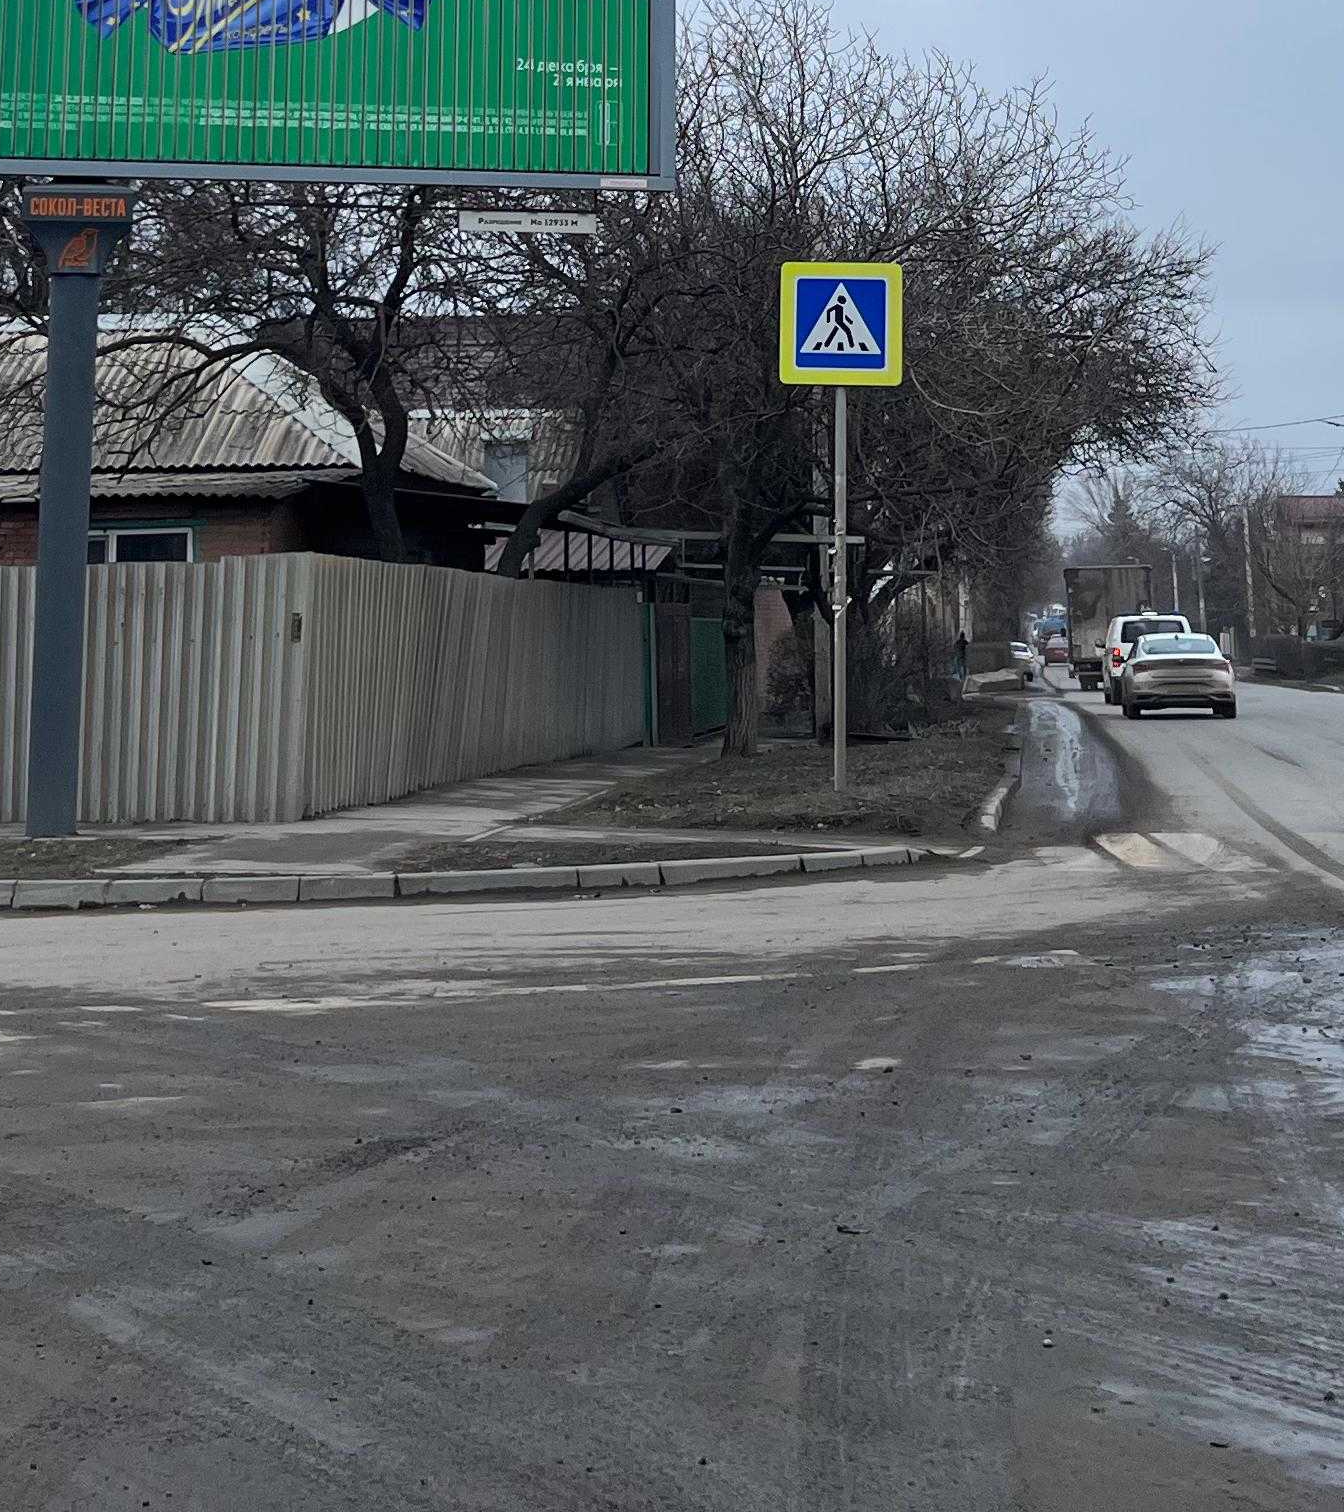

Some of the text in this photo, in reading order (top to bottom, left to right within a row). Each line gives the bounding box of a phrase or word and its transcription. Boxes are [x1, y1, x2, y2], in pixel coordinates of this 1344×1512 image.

[516, 58, 534, 71] 24
[537, 59, 603, 75] декабря
[565, 76, 622, 90] января
[30, 197, 125, 217] СОКОЛ-ВЕСТА
